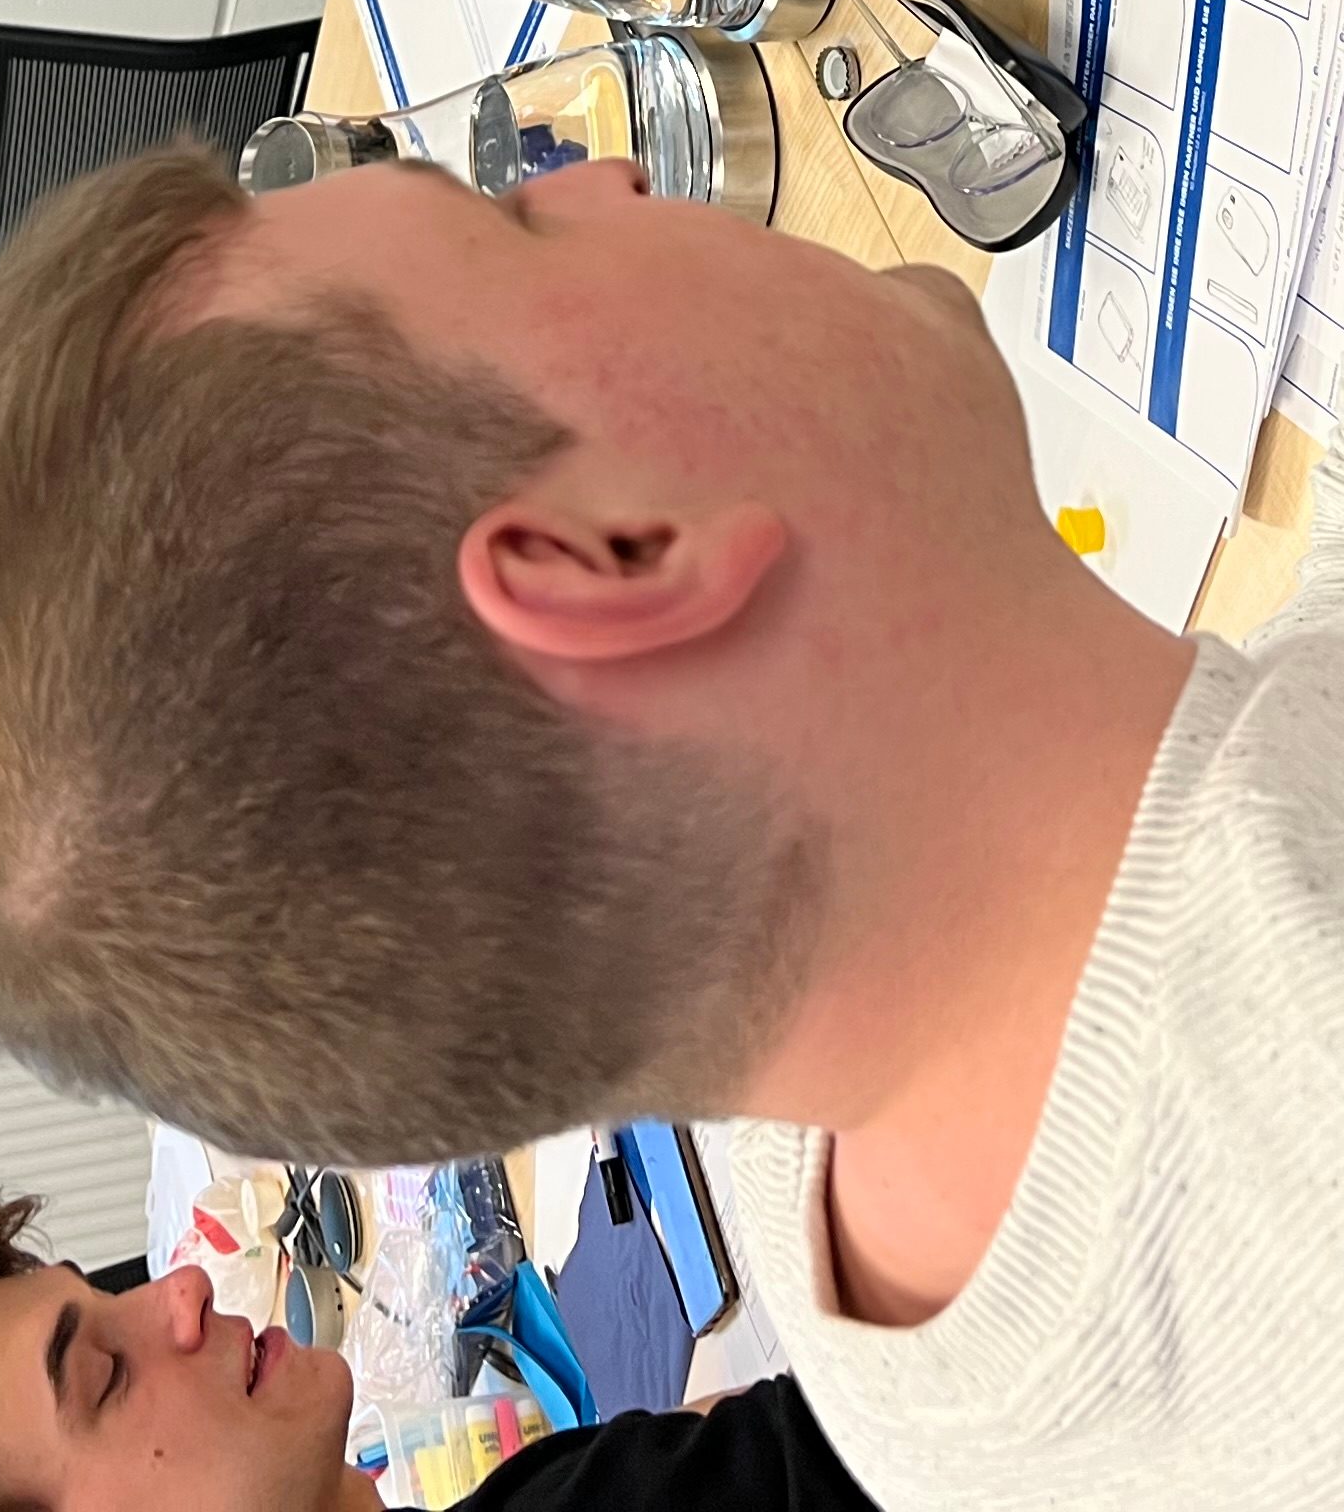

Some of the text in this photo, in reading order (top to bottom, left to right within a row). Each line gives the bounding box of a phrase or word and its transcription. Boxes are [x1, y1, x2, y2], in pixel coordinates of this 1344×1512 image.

[1201, 6, 1210, 25] SIE
[1194, 26, 1208, 85] SAMMELN
[1190, 86, 1202, 113] UND
[1182, 113, 1197, 170] PARTNER
[1175, 209, 1186, 237] IDEE
[1171, 238, 1182, 266] IHRE
[1169, 268, 1179, 286] SIE
[1165, 288, 1177, 331] ZEIGEN
